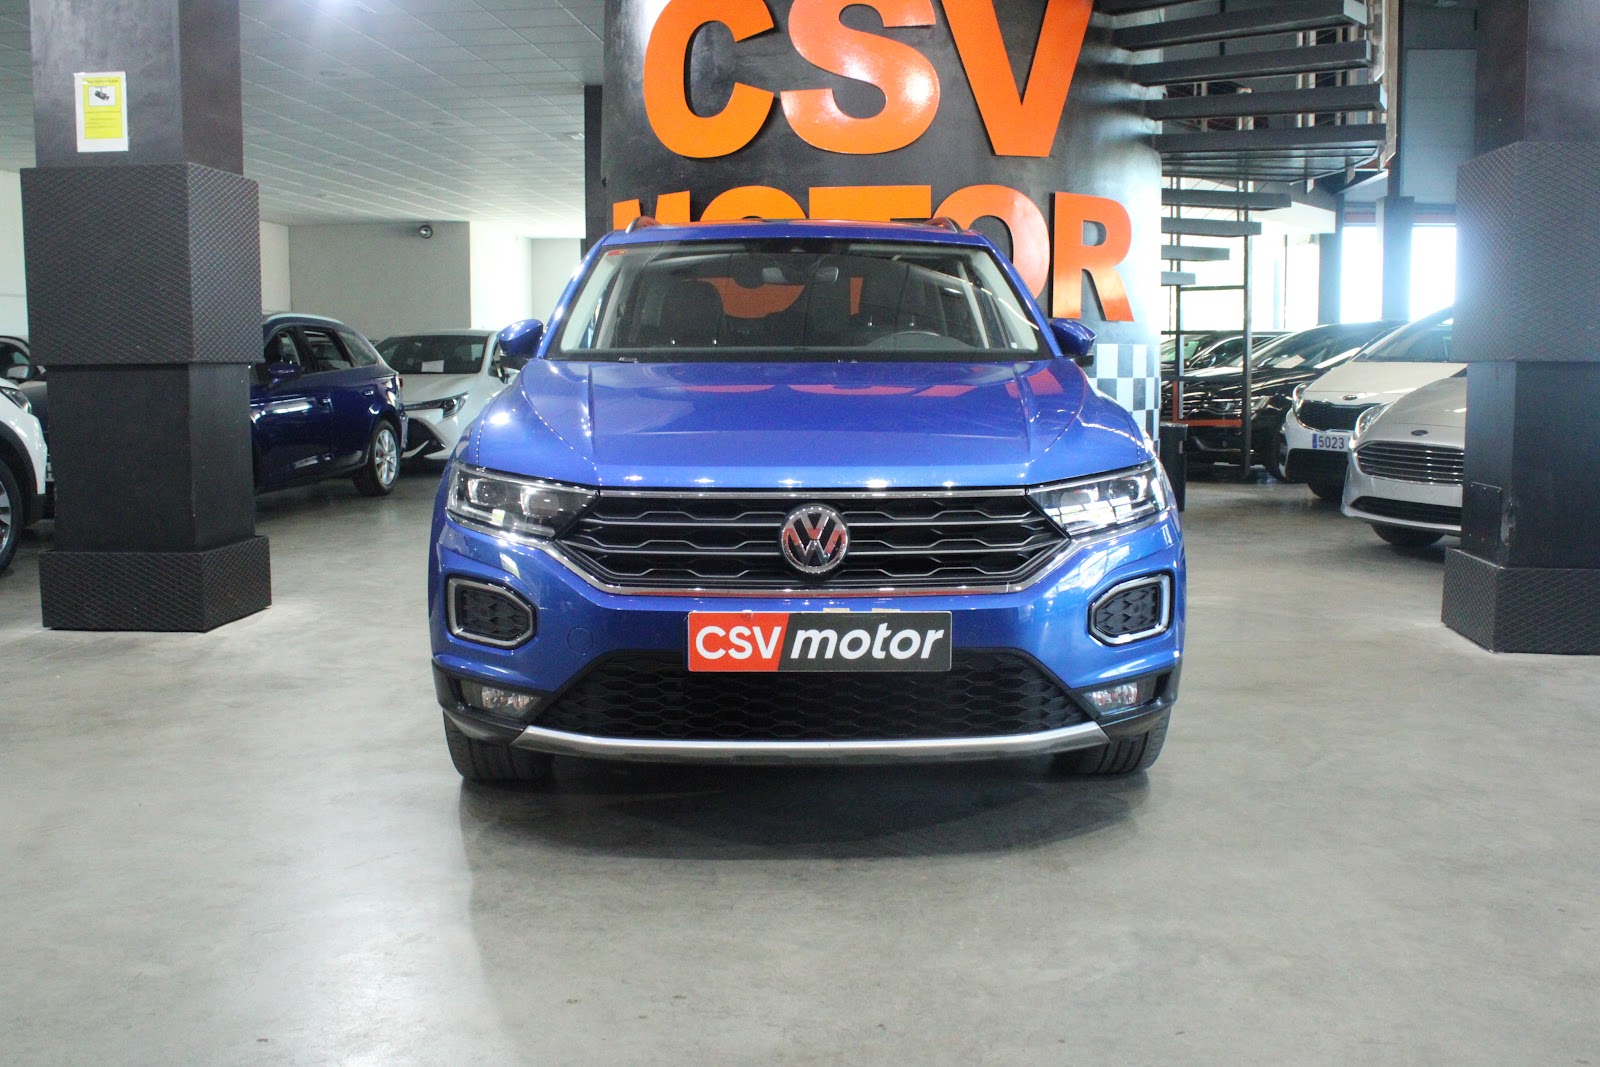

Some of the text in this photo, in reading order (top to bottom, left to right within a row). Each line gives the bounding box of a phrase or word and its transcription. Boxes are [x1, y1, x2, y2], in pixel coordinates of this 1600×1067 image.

[643, 0, 1093, 158] CSV
[1318, 436, 1345, 450] 5023
[695, 622, 945, 660] CSV motor
